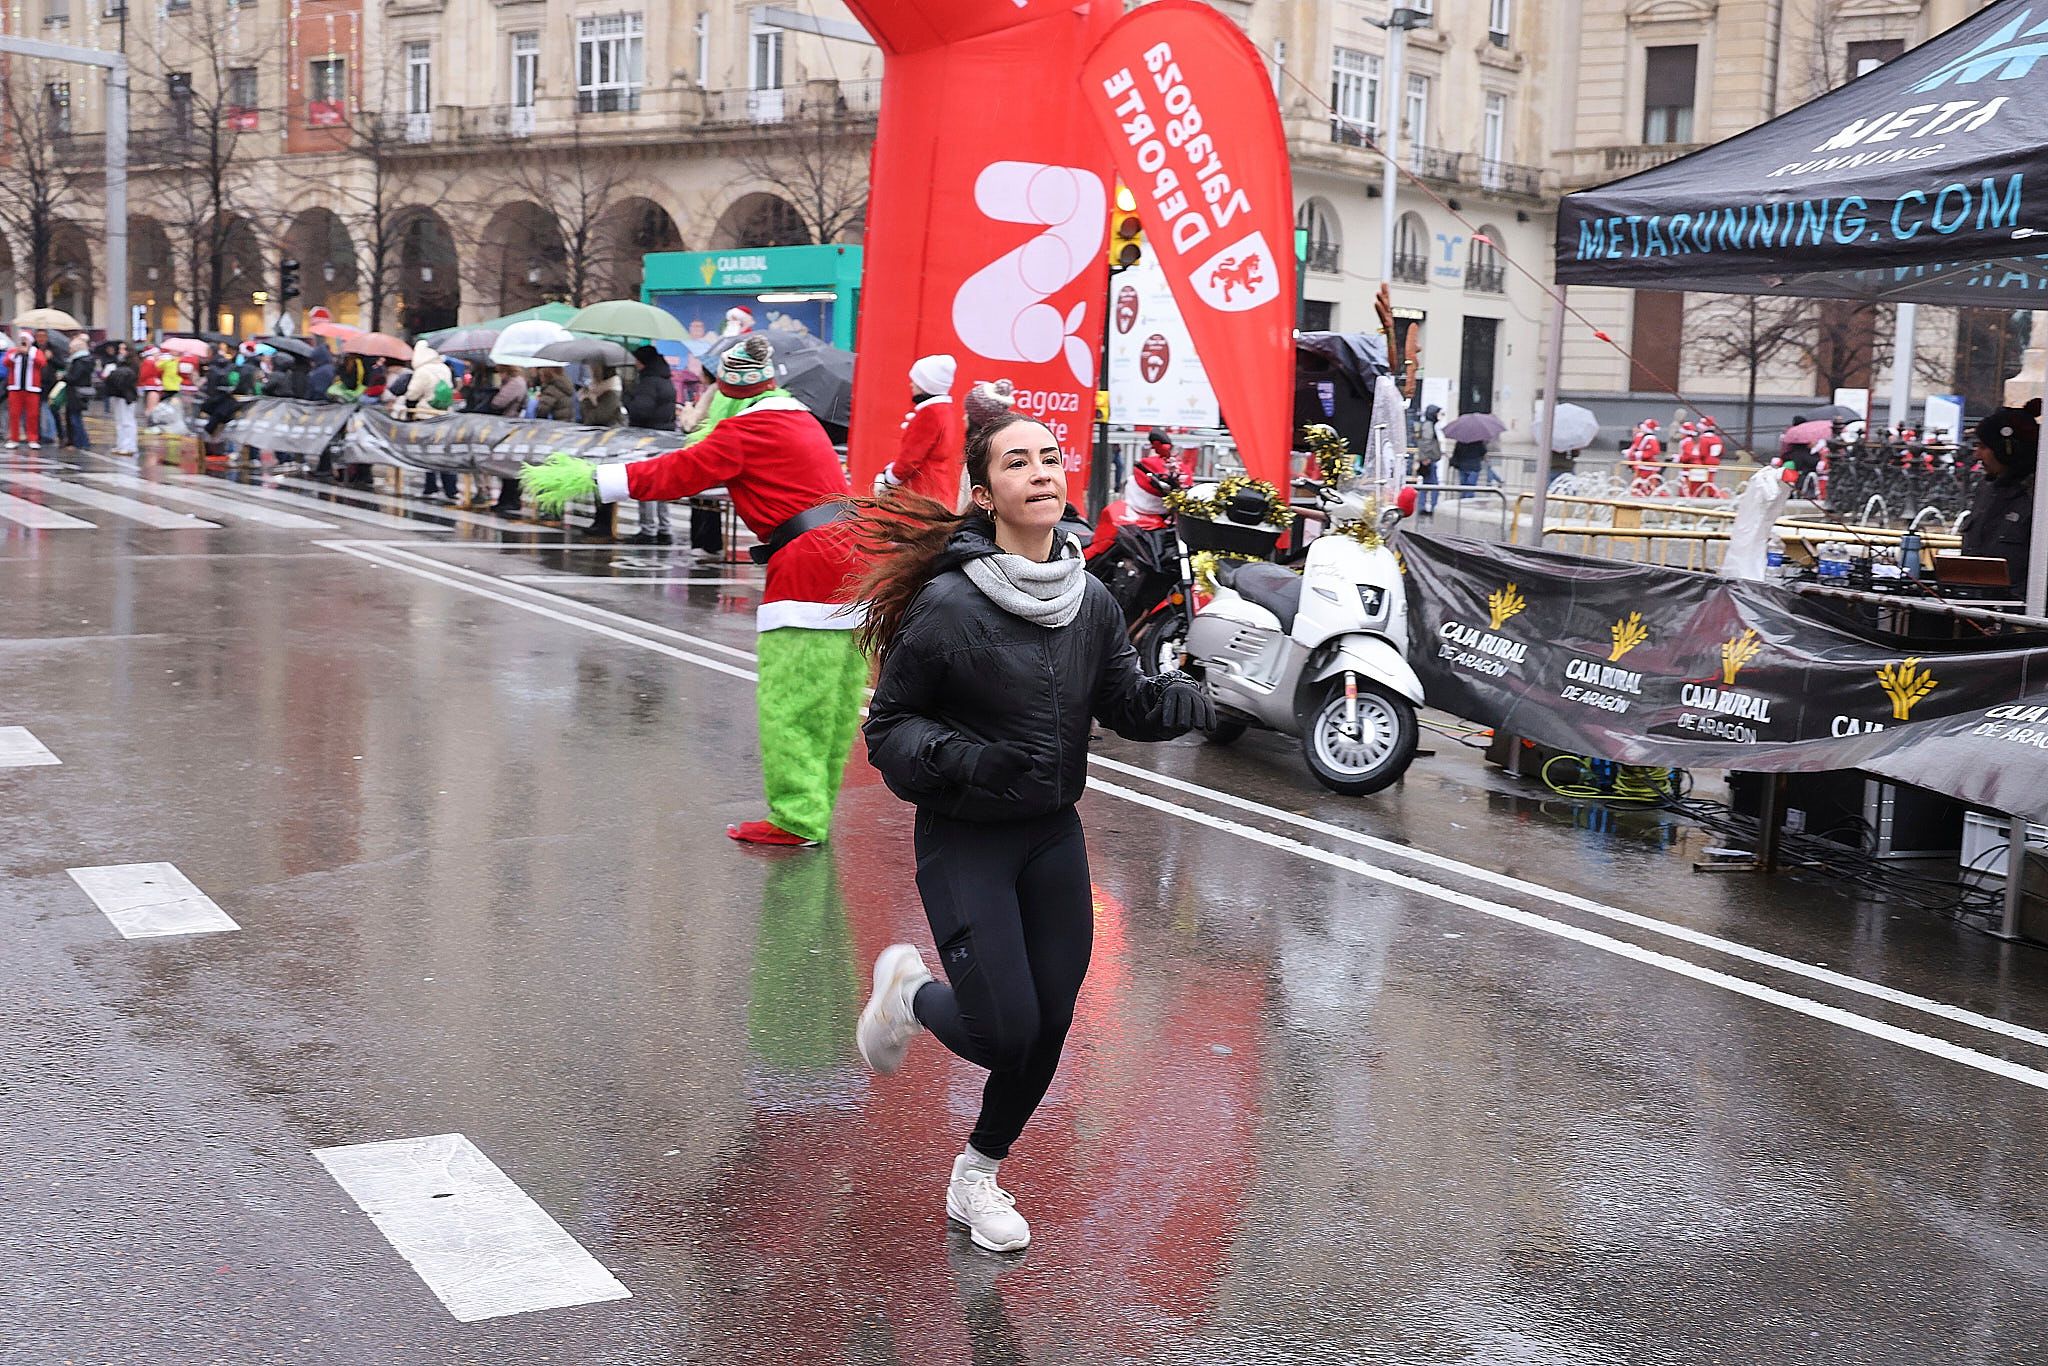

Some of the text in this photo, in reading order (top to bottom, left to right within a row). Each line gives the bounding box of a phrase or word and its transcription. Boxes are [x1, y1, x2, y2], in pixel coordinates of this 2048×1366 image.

[1811, 97, 2010, 153] META
[1766, 144, 1946, 178] RUNNING
[1576, 173, 2024, 261] METARUNNING.COM
[1437, 643, 1509, 677] DE ARAGÓN
[1439, 621, 1528, 664] CAJA RURAL
[1565, 658, 1642, 694] CAJA RURAL
[1560, 685, 1631, 714] DE ARAGÓN
[1681, 683, 1771, 723] CAJA RURAL
[1677, 712, 1758, 744] DE ARAGÓN
[1973, 722, 2008, 738] DE
